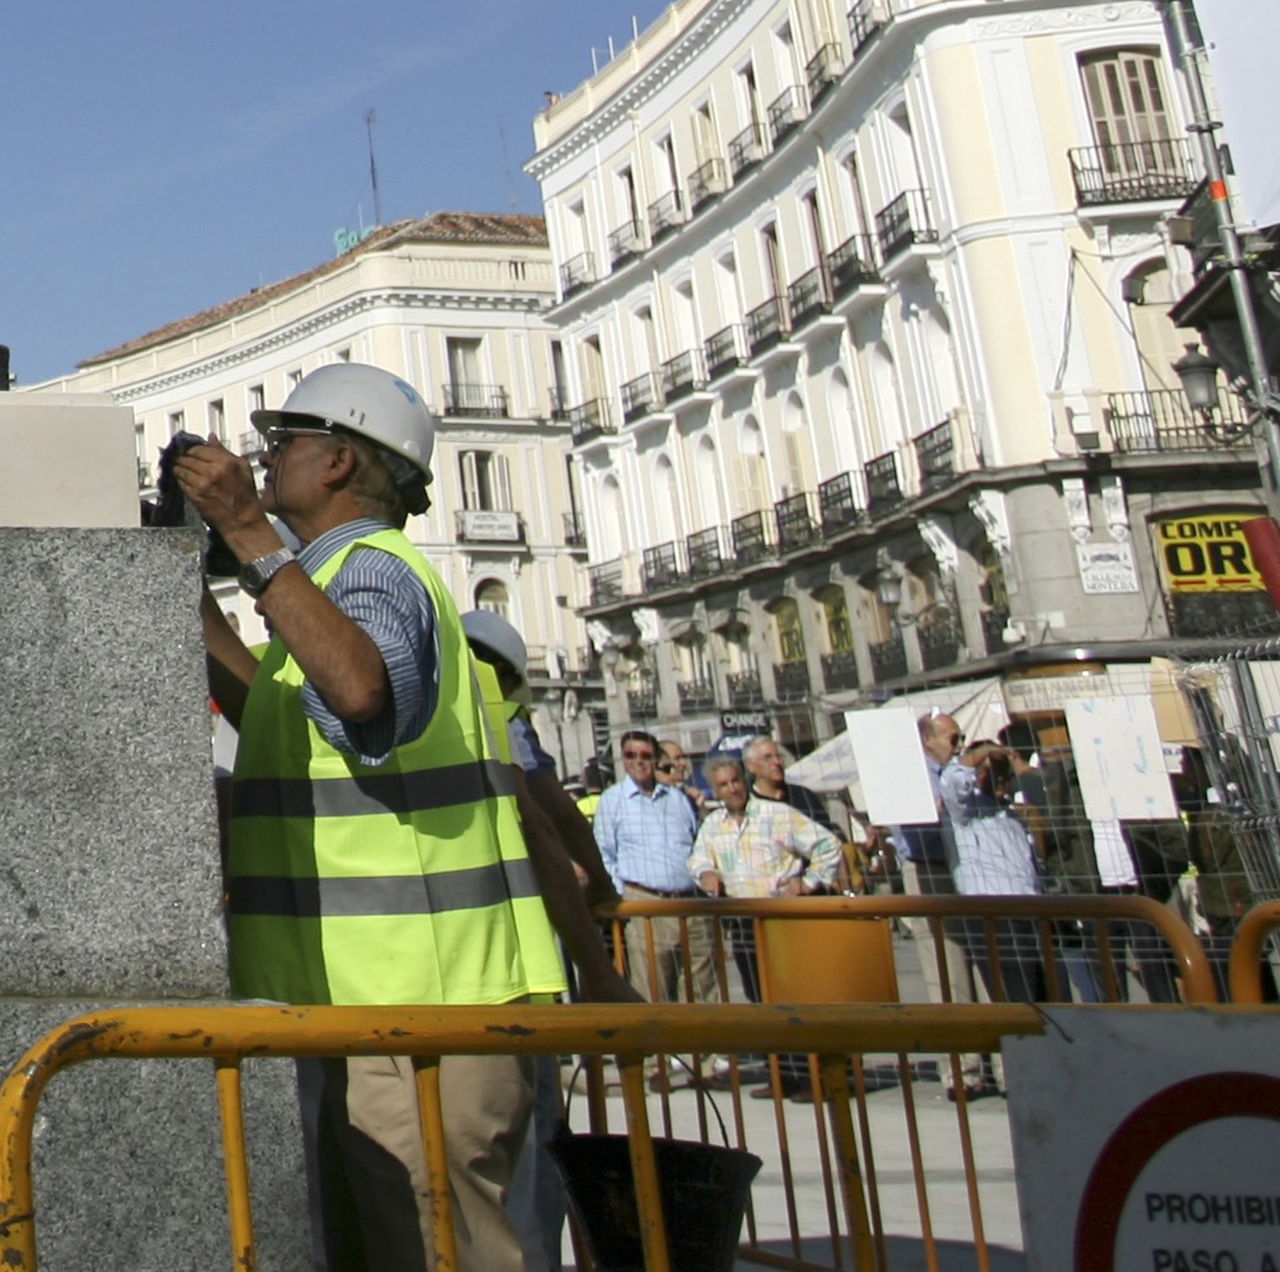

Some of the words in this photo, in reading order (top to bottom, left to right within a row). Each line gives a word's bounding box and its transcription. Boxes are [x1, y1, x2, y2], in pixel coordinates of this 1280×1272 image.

[723, 713, 766, 727] CHANGE
[1146, 1193, 1280, 1225] PROHIBI
[1152, 1248, 1238, 1272] PASO
